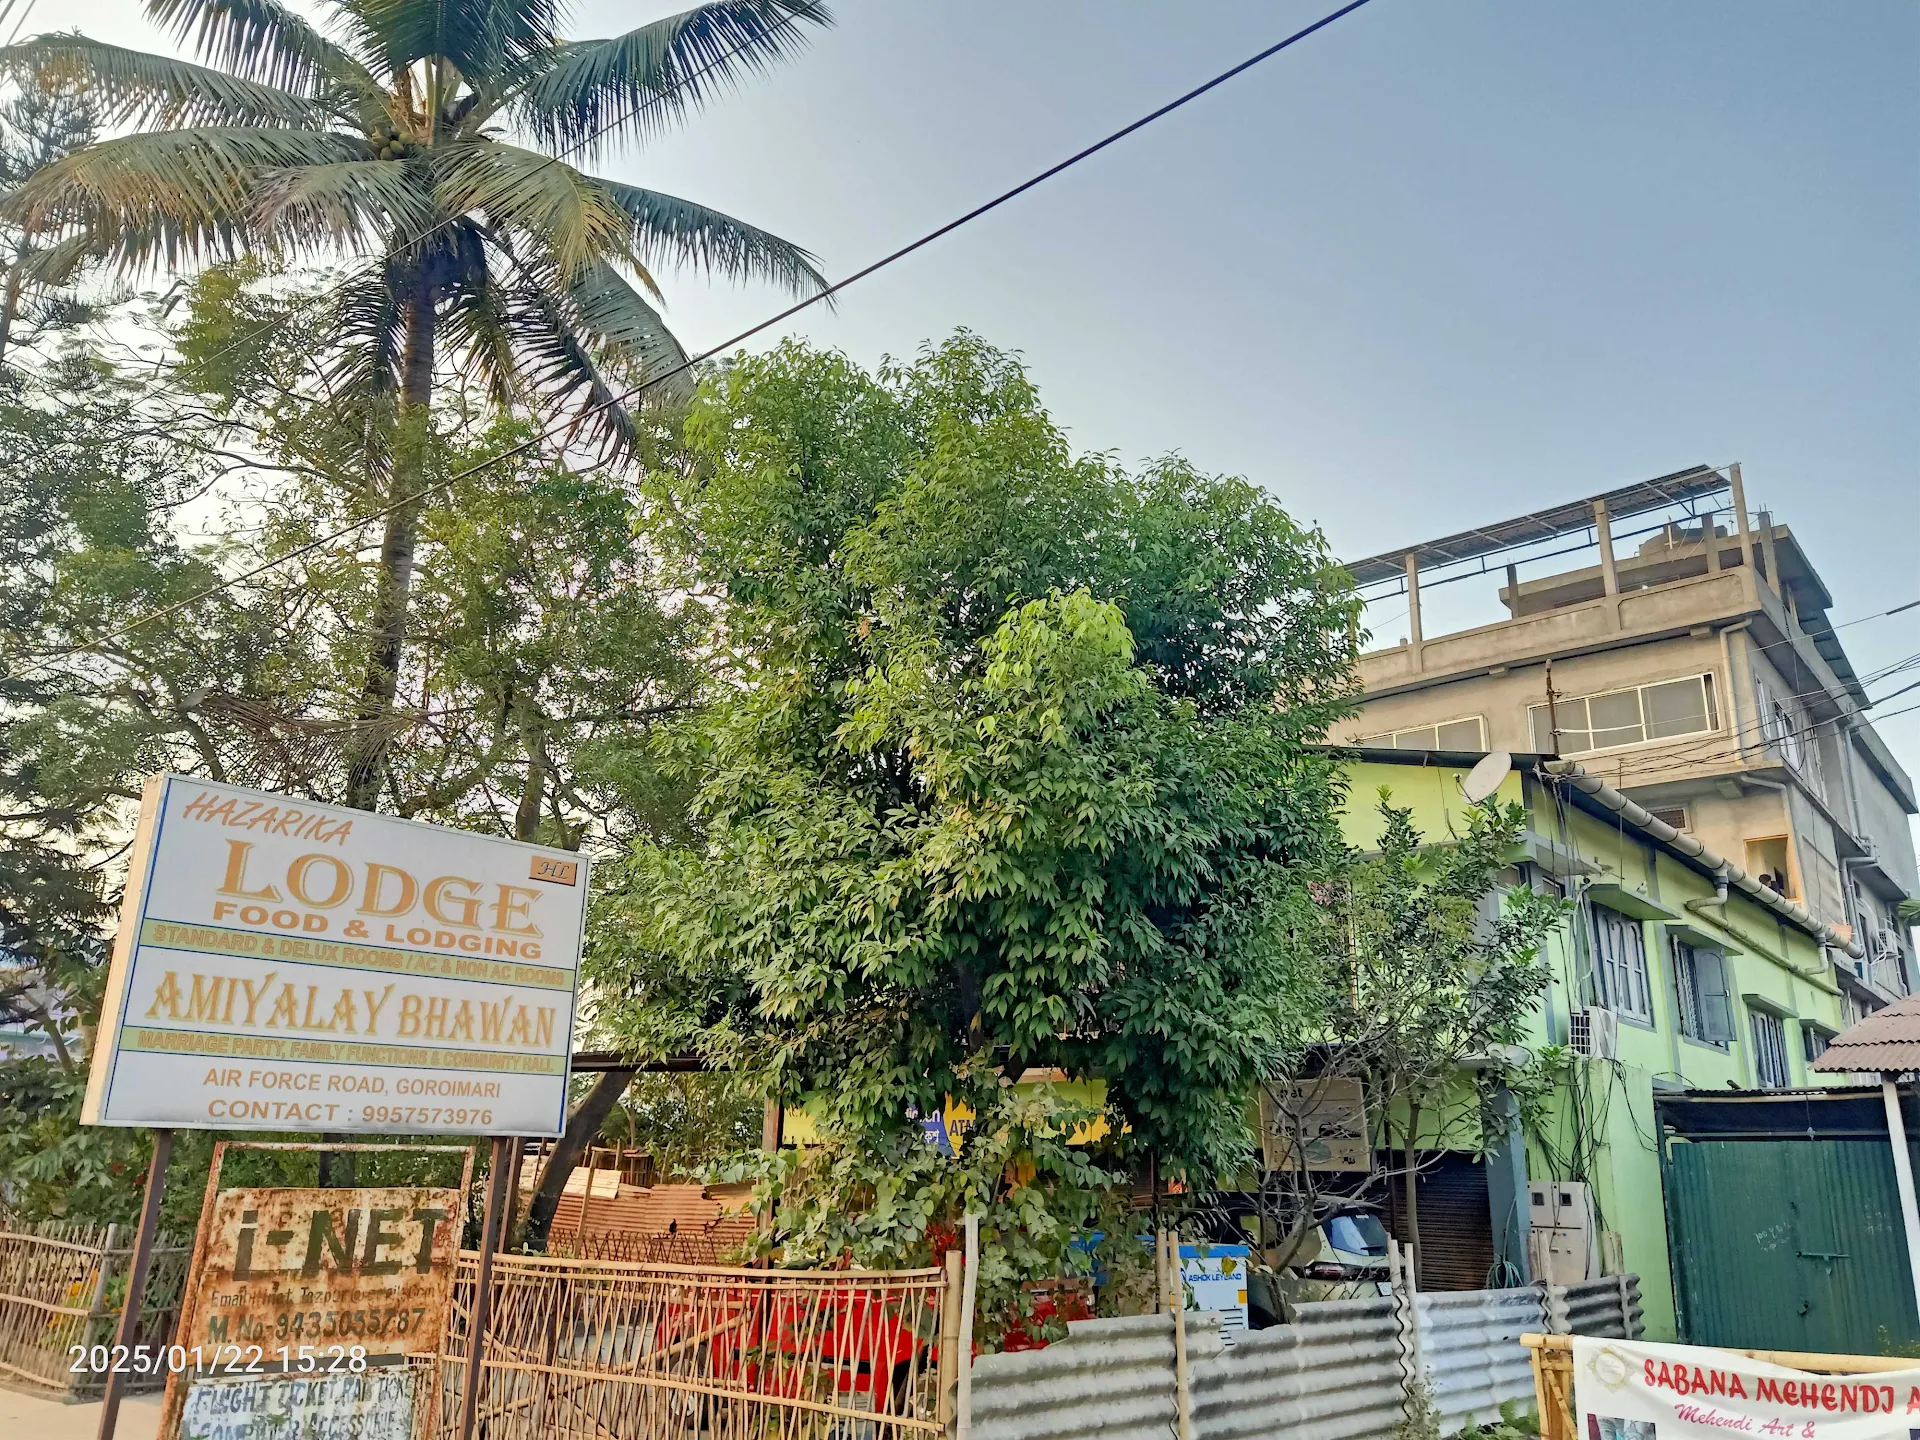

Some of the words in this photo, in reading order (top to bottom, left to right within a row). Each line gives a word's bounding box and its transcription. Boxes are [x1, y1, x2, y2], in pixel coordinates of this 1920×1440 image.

[182, 791, 353, 846] HAZARIKA
[216, 838, 544, 939] LODGE
[153, 924, 258, 951] STANDARD
[262, 938, 275, 955] &
[279, 939, 339, 962] DELUX
[342, 946, 403, 969] ROOMS
[406, 954, 413, 970] /
[414, 956, 438, 972] AC
[440, 958, 452, 974] &
[456, 960, 488, 978] NON
[490, 965, 511, 980] AC
[515, 967, 565, 986] ROOMS
[213, 901, 329, 933] FOOD
[343, 919, 370, 939] &
[385, 923, 542, 960] LODGING
[144, 970, 396, 1037] AMIYALAY
[396, 994, 557, 1049] BHAWAN
[137, 1030, 230, 1054] MARRIAGE
[232, 1037, 286, 1059] PARTY,
[290, 1041, 347, 1061] FAMILY
[346, 1045, 428, 1065] FUNCTIONS
[430, 1050, 441, 1066] &
[443, 1052, 522, 1072] COMMUNITY
[522, 1056, 554, 1073] HALL
[203, 1068, 242, 1089] AIR
[248, 1072, 321, 1093] FORCE
[326, 1074, 389, 1098] ROAD,
[395, 1077, 502, 1099] GOROIMARI
[208, 1099, 341, 1122] CONTACT
[361, 1105, 493, 1126] 9957573976
[233, 1207, 449, 1282] i-NET
[1188, 1273, 1211, 1282] ASHOK
[1643, 1358, 1748, 1400] SABANA
[1674, 1403, 1752, 1431] Mehendi
[1758, 1416, 1795, 1437] Art
[1801, 1420, 1816, 1439] &
